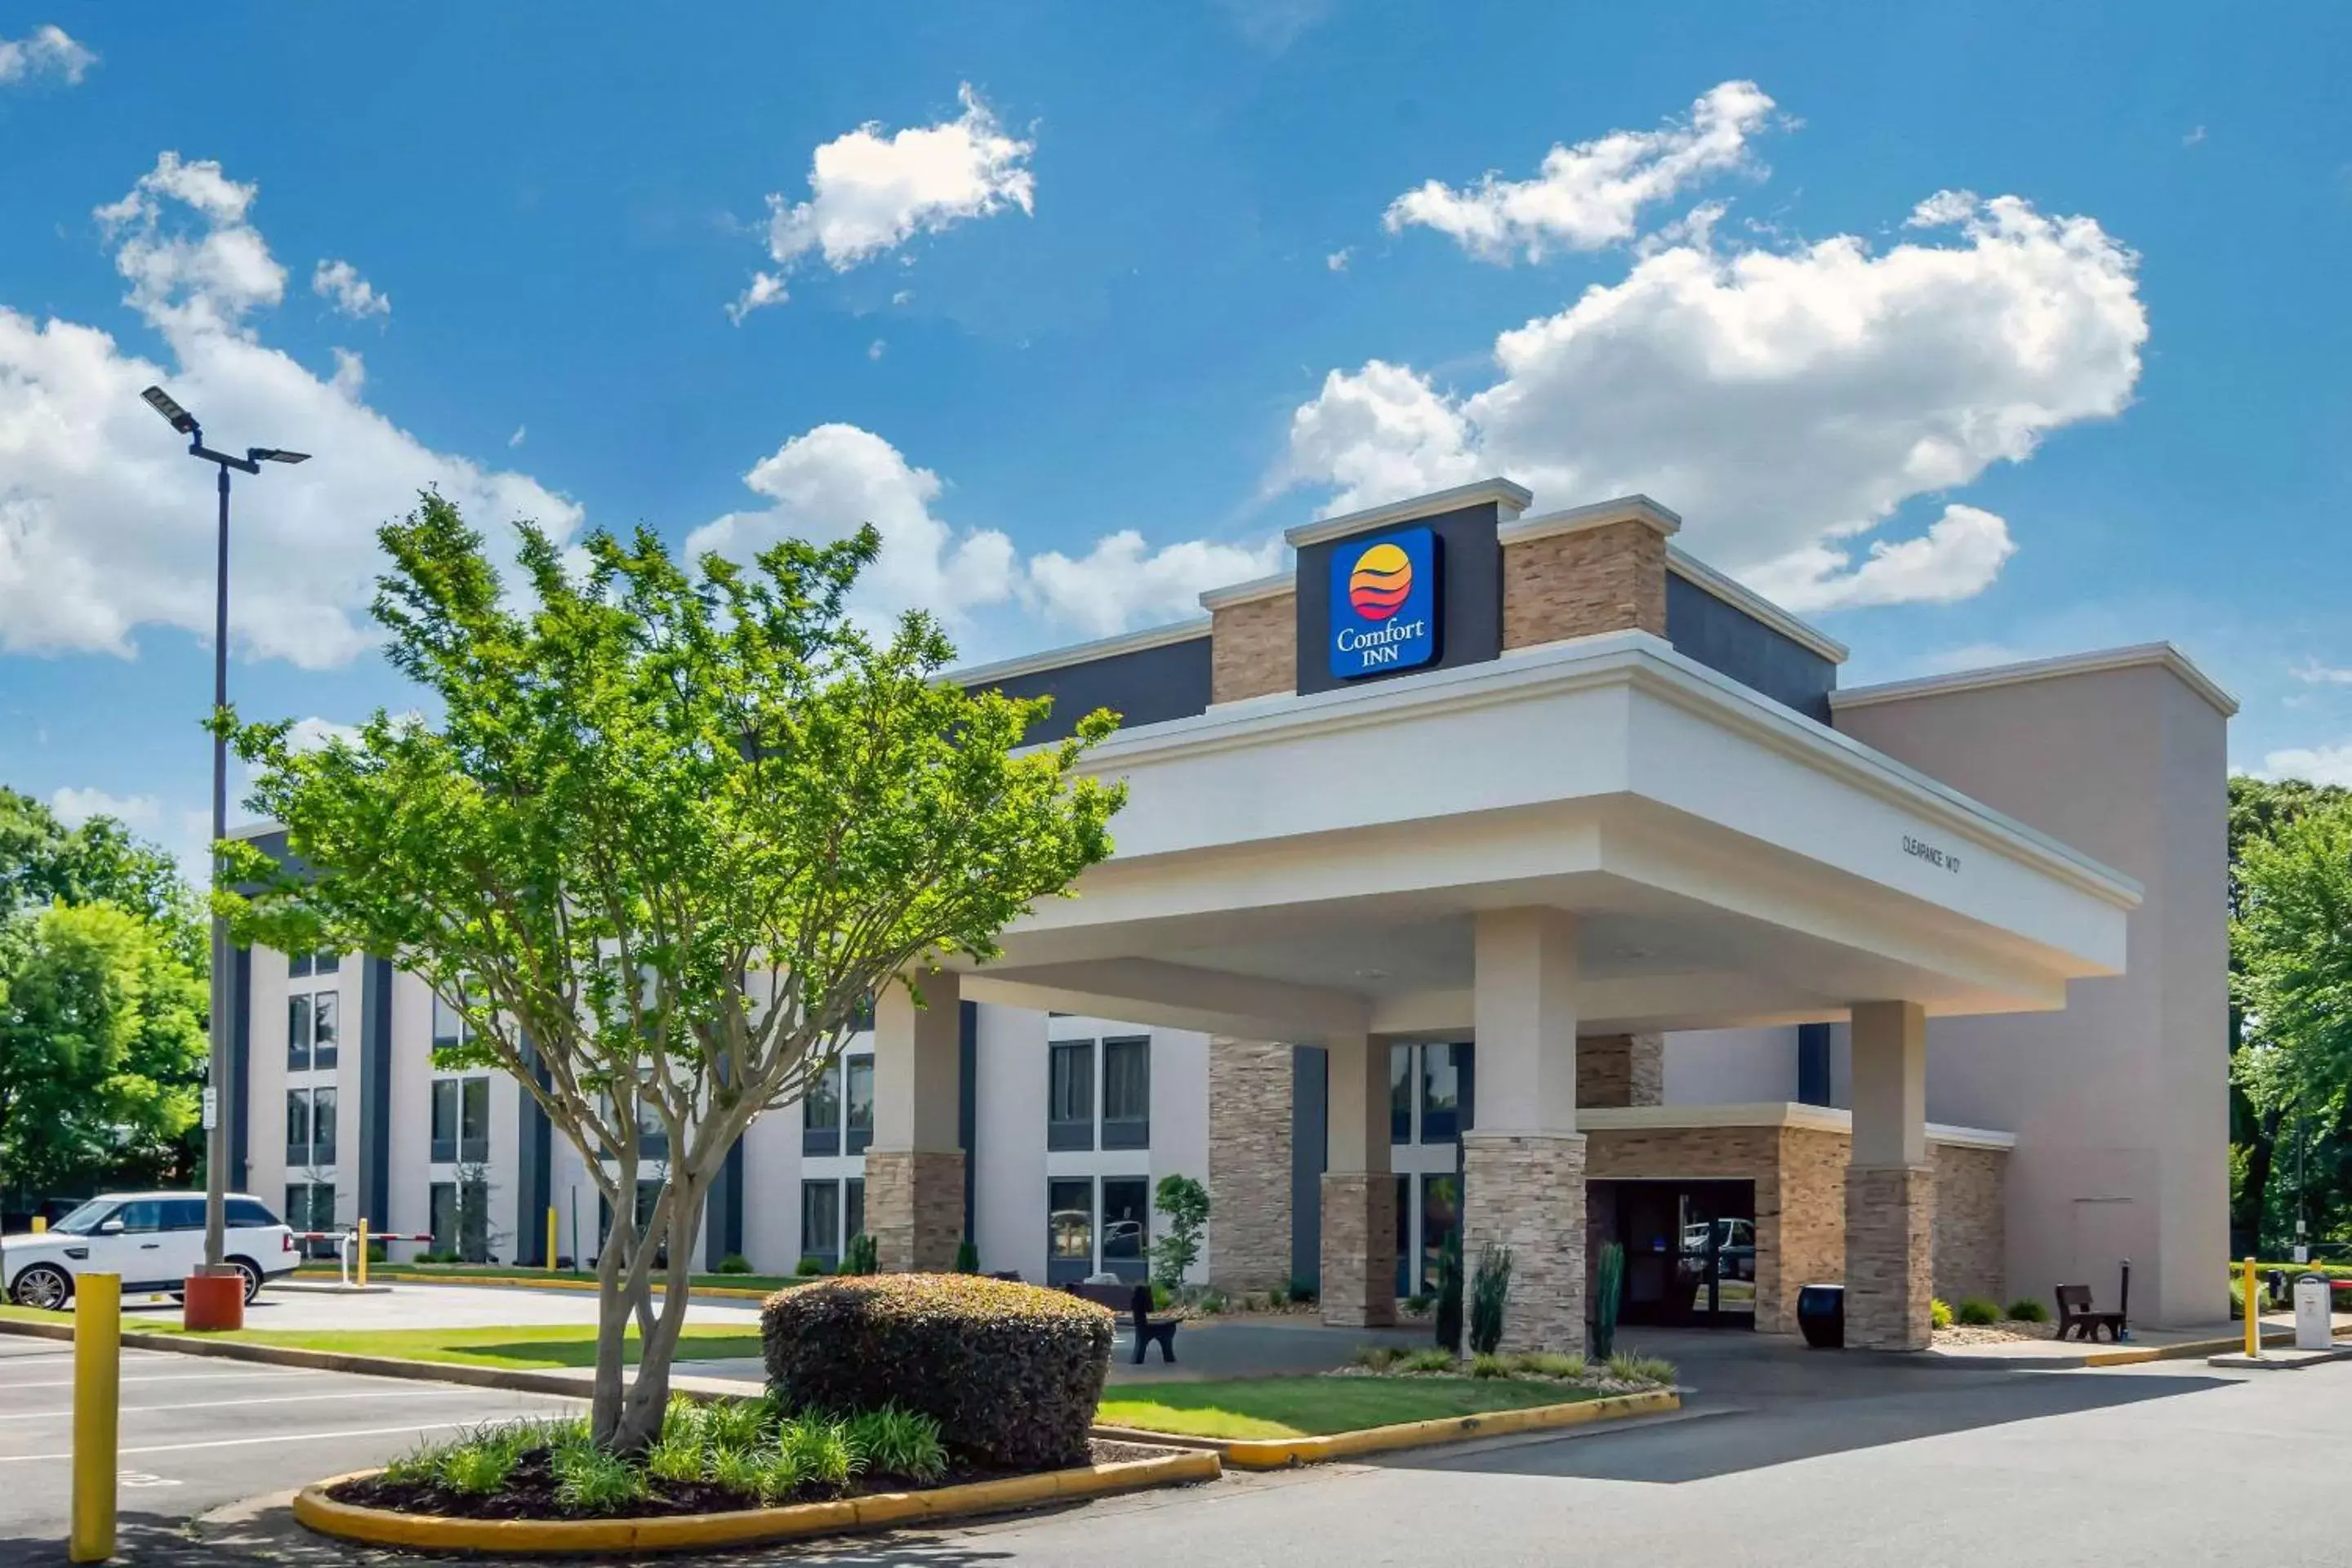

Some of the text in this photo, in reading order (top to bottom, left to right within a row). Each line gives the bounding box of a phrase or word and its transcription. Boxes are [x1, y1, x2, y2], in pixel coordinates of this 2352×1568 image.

[1338, 618, 1424, 651] Comfort
[1362, 645, 1398, 666] INN
[1903, 835, 1943, 867] CLEARANCE
